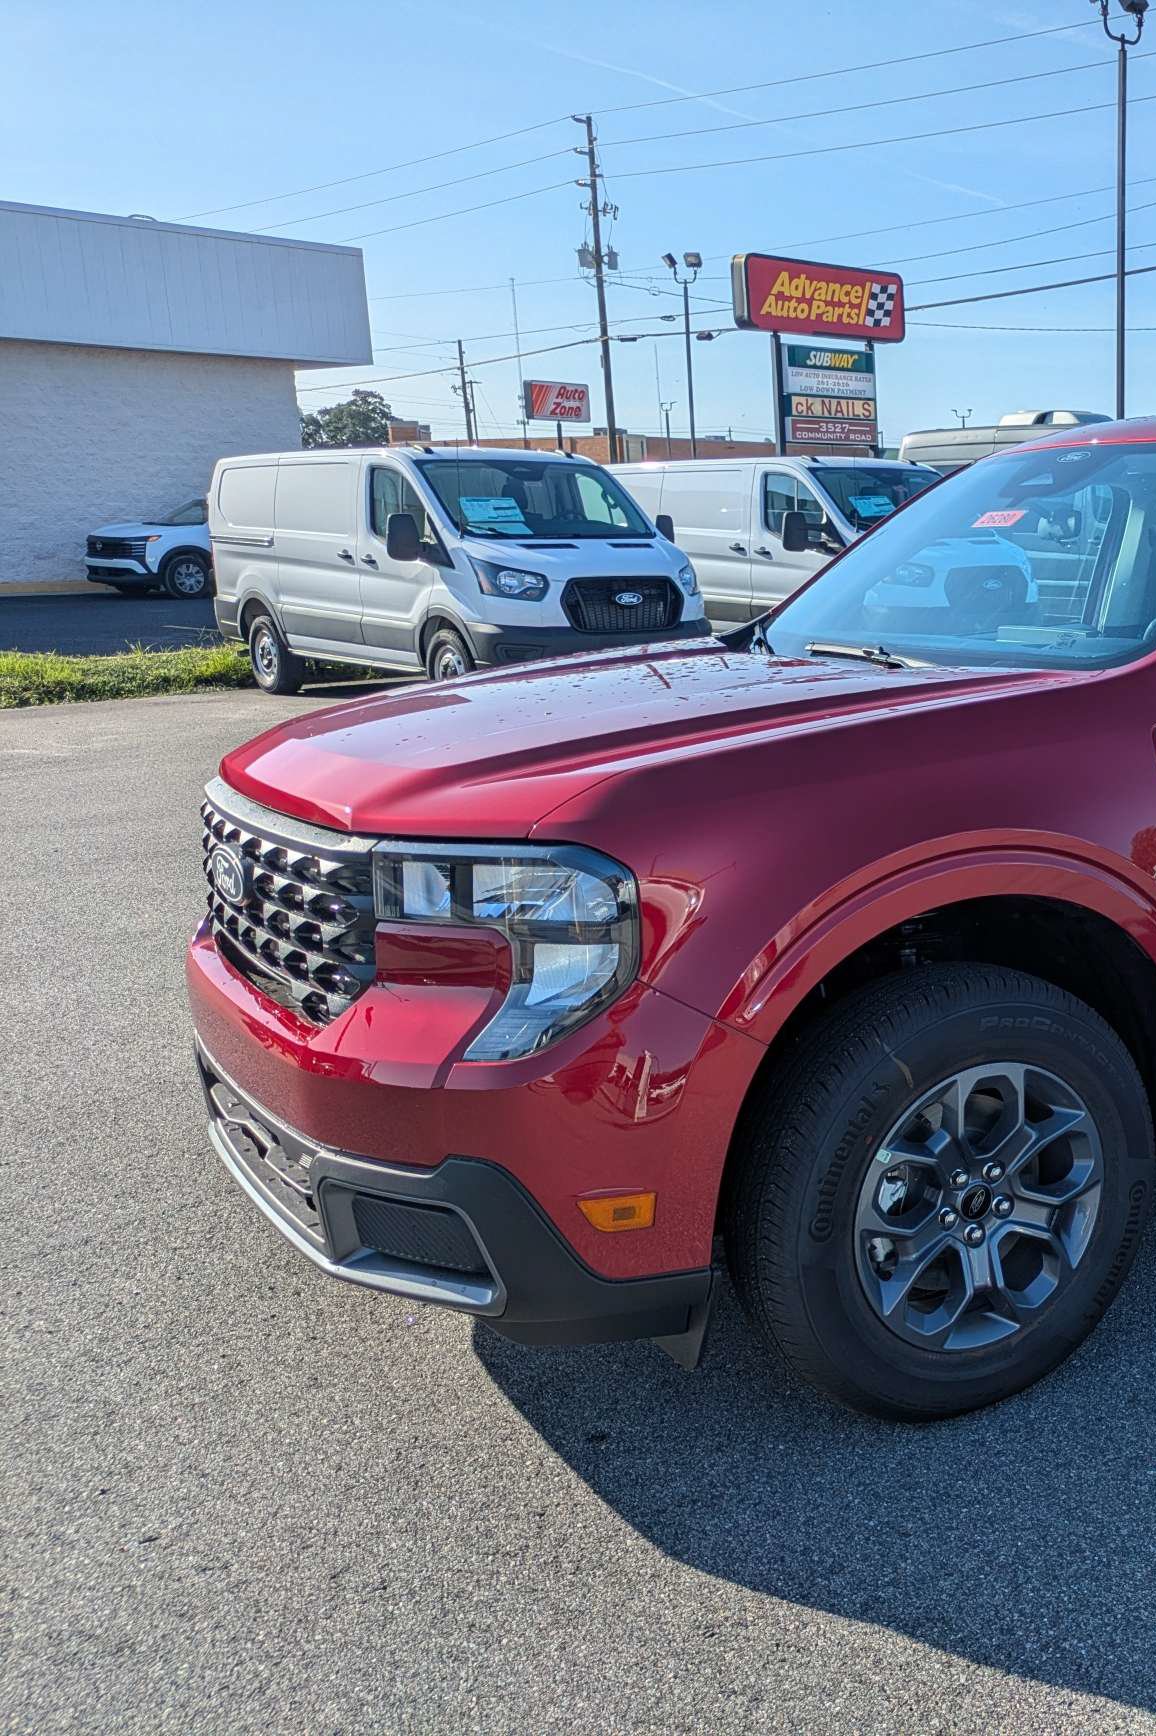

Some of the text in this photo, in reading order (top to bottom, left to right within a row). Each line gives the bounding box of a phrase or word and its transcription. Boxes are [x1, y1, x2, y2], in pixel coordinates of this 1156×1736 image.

[771, 271, 863, 305] Advance
[760, 295, 859, 325] Auto Parts
[806, 351, 857, 368] SUBWAY
[805, 372, 820, 380] AUTO
[555, 385, 586, 401] Auto
[800, 385, 867, 396] LOW DOWN PAYMENT
[549, 401, 582, 417] Zone
[795, 398, 872, 419] ck NAILS
[819, 422, 849, 432] 3527
[796, 431, 872, 441] COMMUNITY ROAD
[216, 855, 236, 895] Ford
[808, 1093, 877, 1243] Continental
